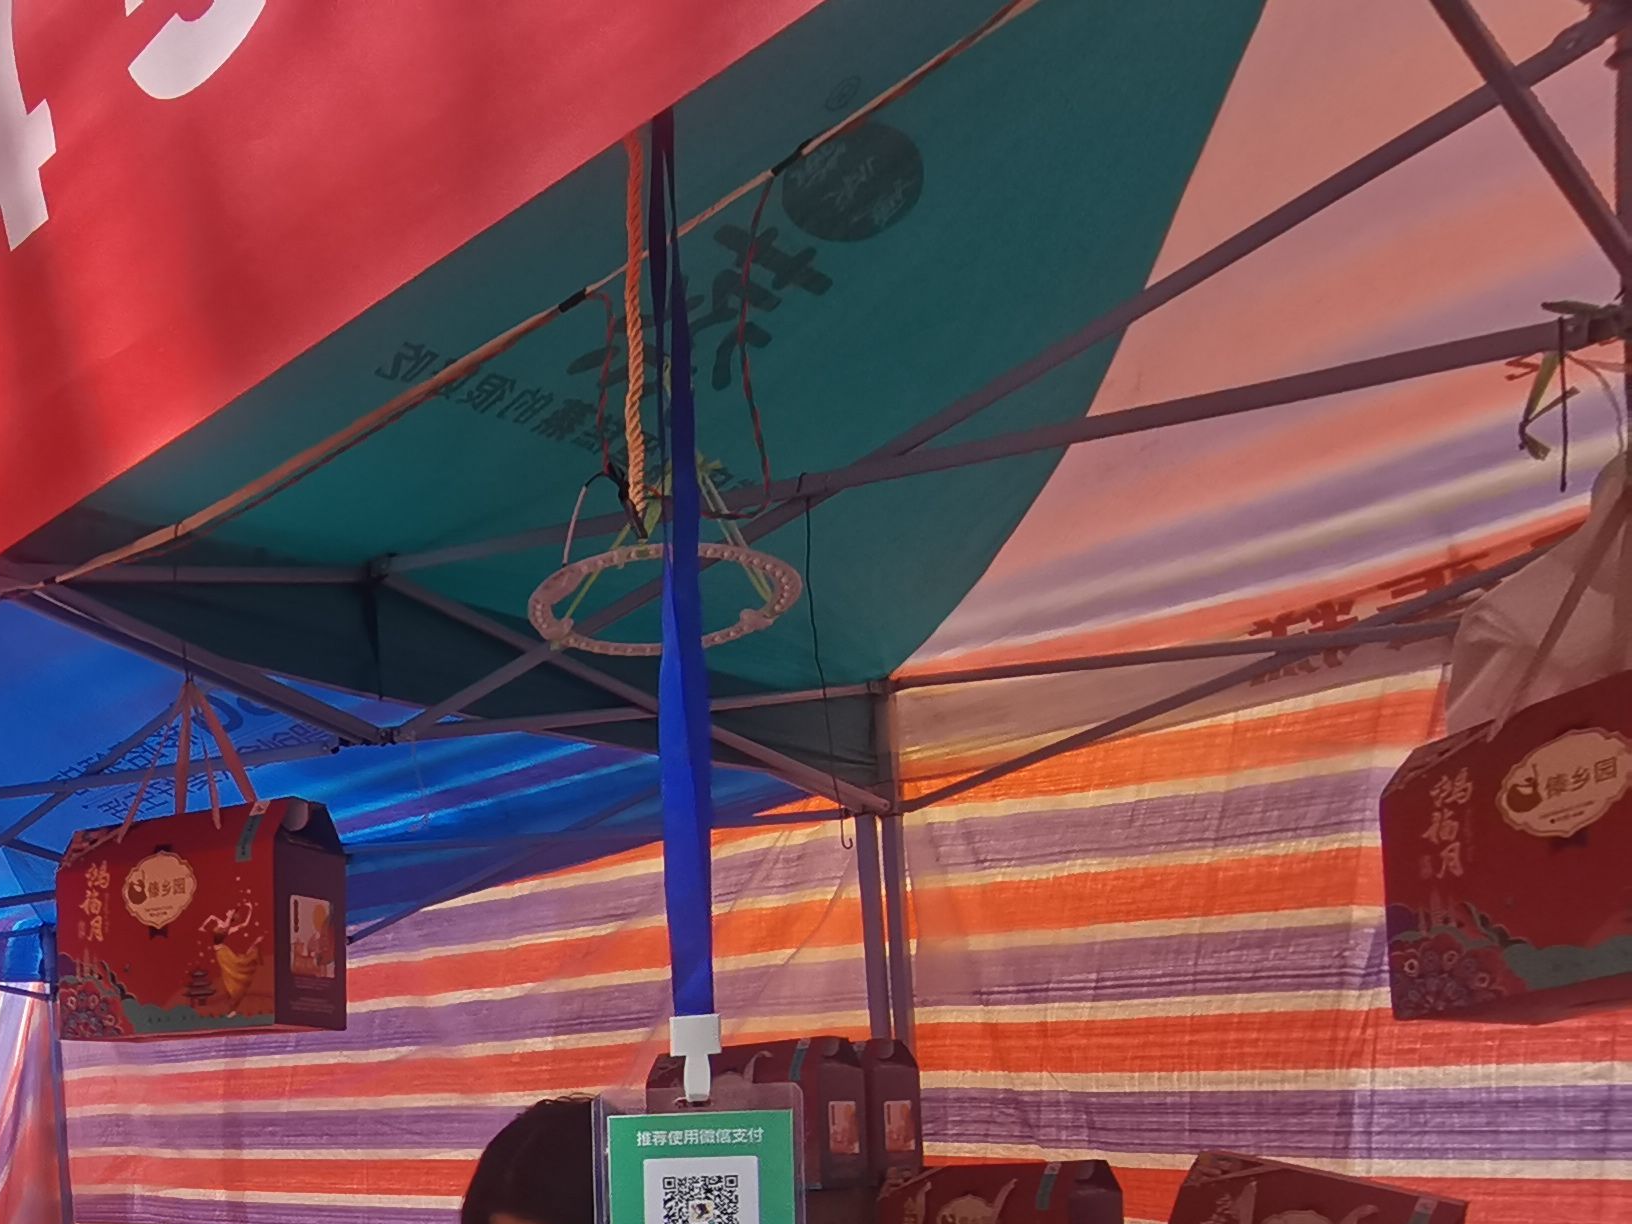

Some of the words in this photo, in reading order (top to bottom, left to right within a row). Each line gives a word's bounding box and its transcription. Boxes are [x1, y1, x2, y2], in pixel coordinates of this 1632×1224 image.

[636, 1127, 763, 1147] 推荐使用微信支付
